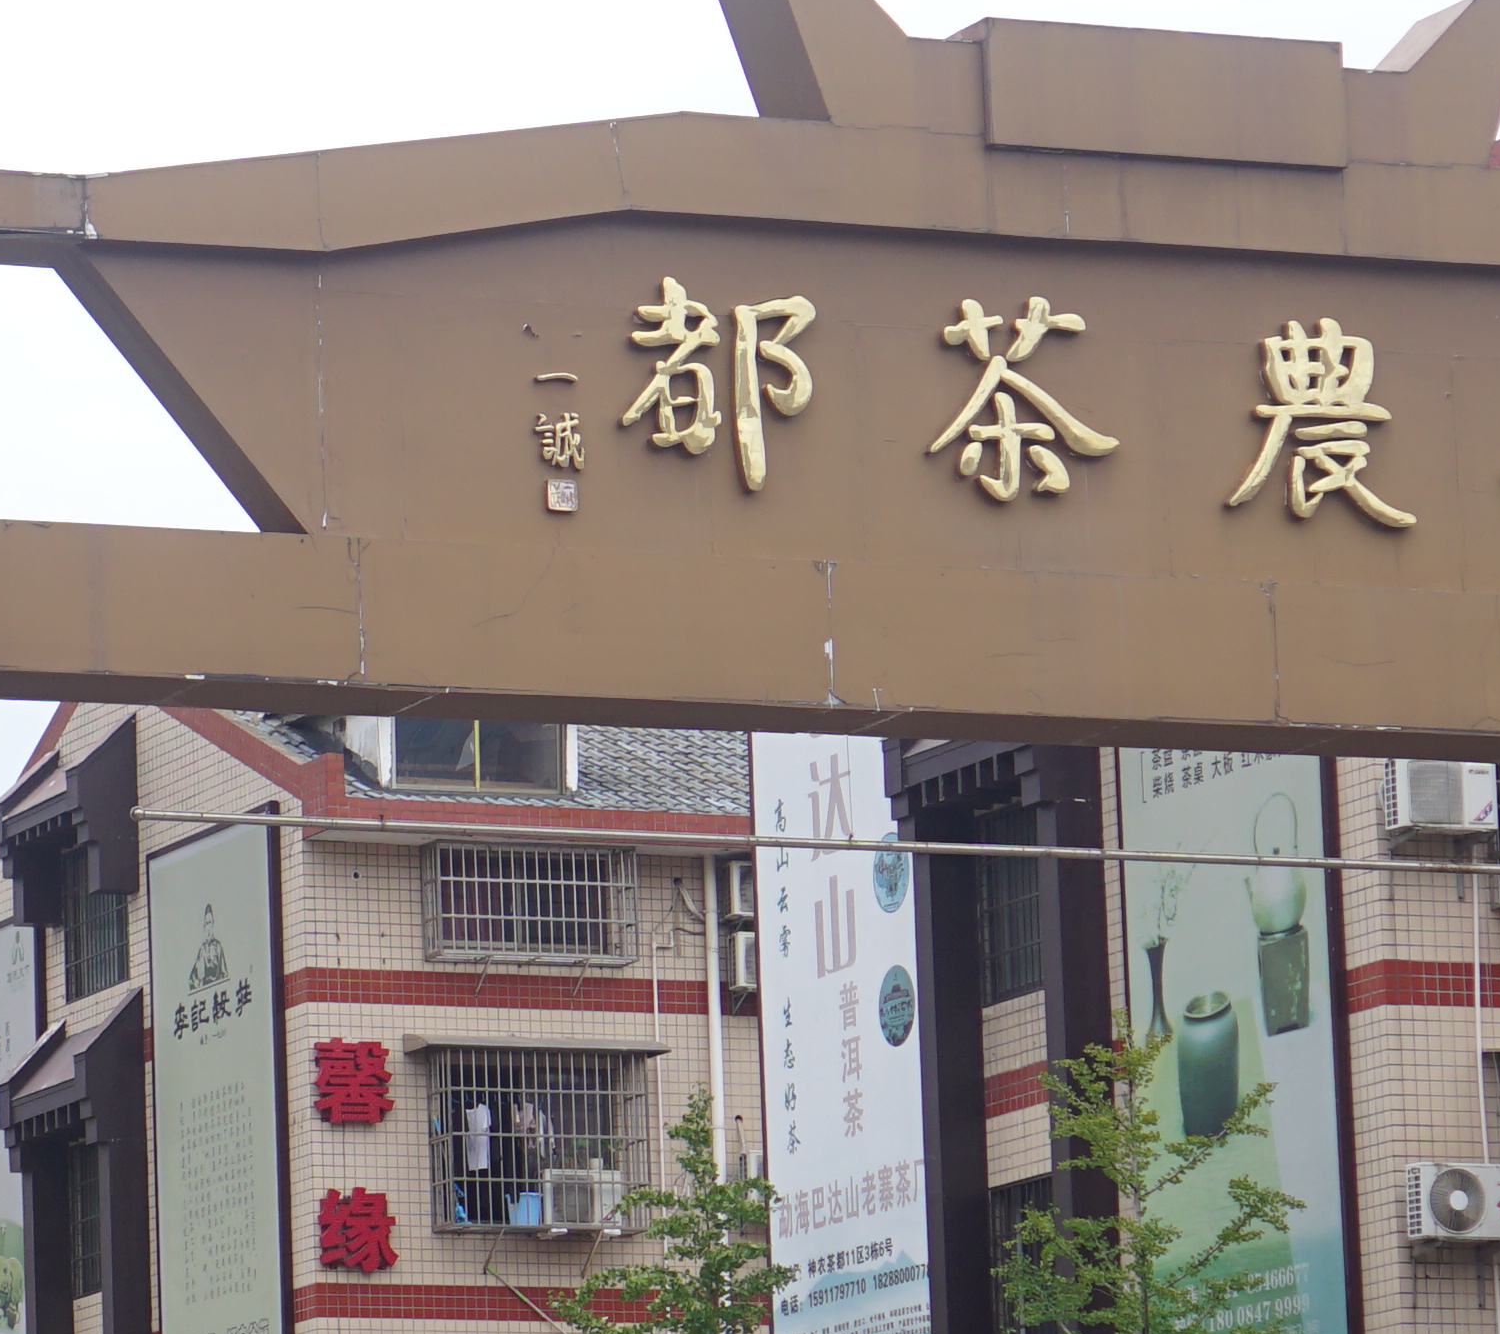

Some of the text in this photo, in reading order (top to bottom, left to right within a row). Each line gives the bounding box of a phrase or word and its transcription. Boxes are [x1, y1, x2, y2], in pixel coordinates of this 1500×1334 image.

[807, 733, 857, 979] 达山
[839, 981, 864, 1137] 普洱茶
